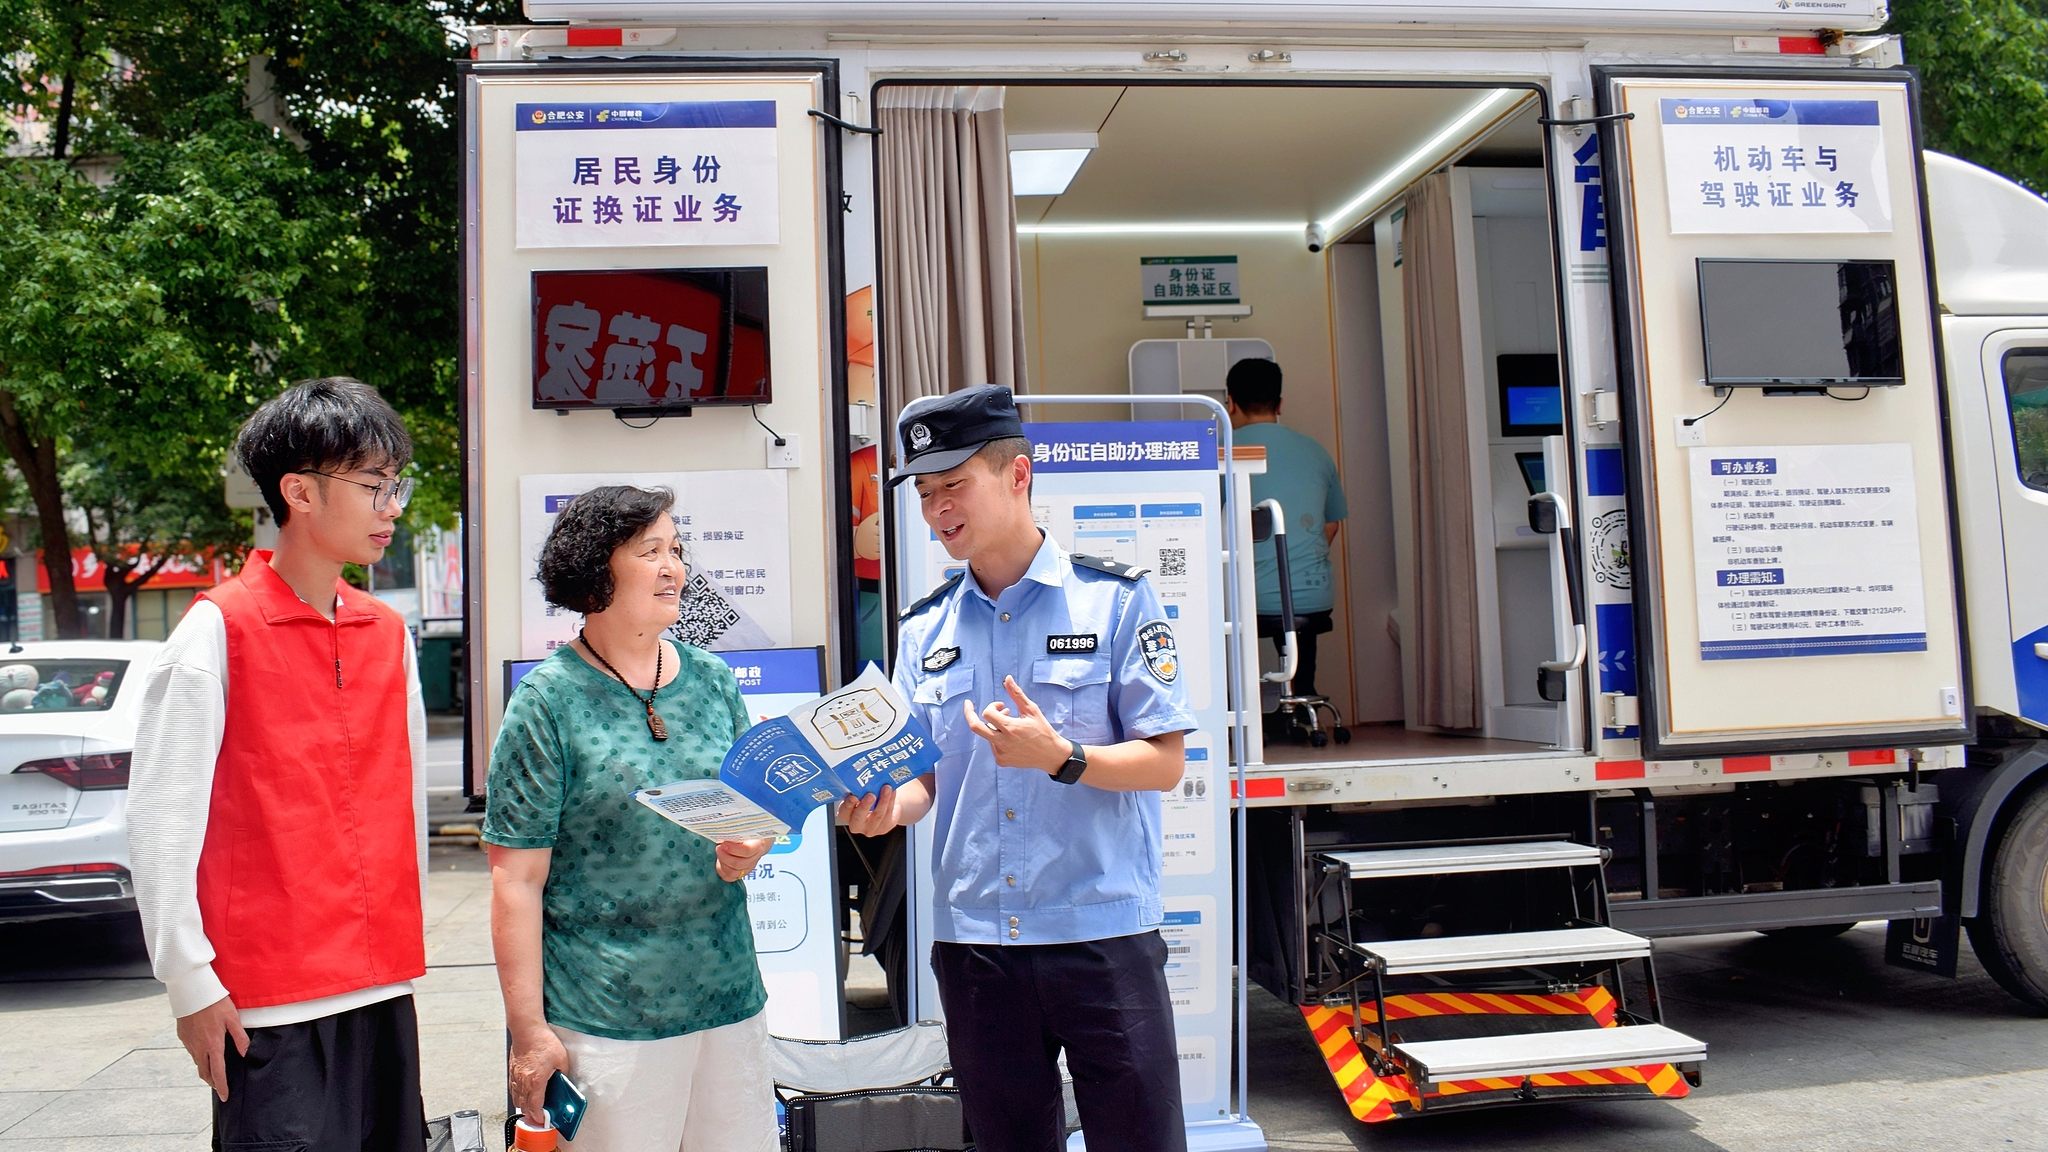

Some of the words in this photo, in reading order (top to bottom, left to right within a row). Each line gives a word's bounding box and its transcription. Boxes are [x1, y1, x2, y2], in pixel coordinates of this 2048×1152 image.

[547, 110, 585, 120] 合肥公安
[611, 110, 643, 118] 中国邮政
[1713, 144, 1838, 173] 机动车与
[572, 155, 722, 186] 居民身份
[1700, 180, 1860, 209] 驾驶证业务
[553, 193, 743, 226] 证换证业务
[1168, 267, 1216, 282] 身份证
[1154, 282, 1233, 298] 自助换证区
[1032, 440, 1200, 464] 身份证自助办理流程
[1720, 461, 1770, 474] 可办业务：
[1726, 571, 1778, 585] 办理需知：
[1049, 637, 1095, 650] 061996
[728, 666, 762, 679] 邮政
[856, 737, 925, 788] 反诈同行
[756, 918, 788, 931] 请到公
